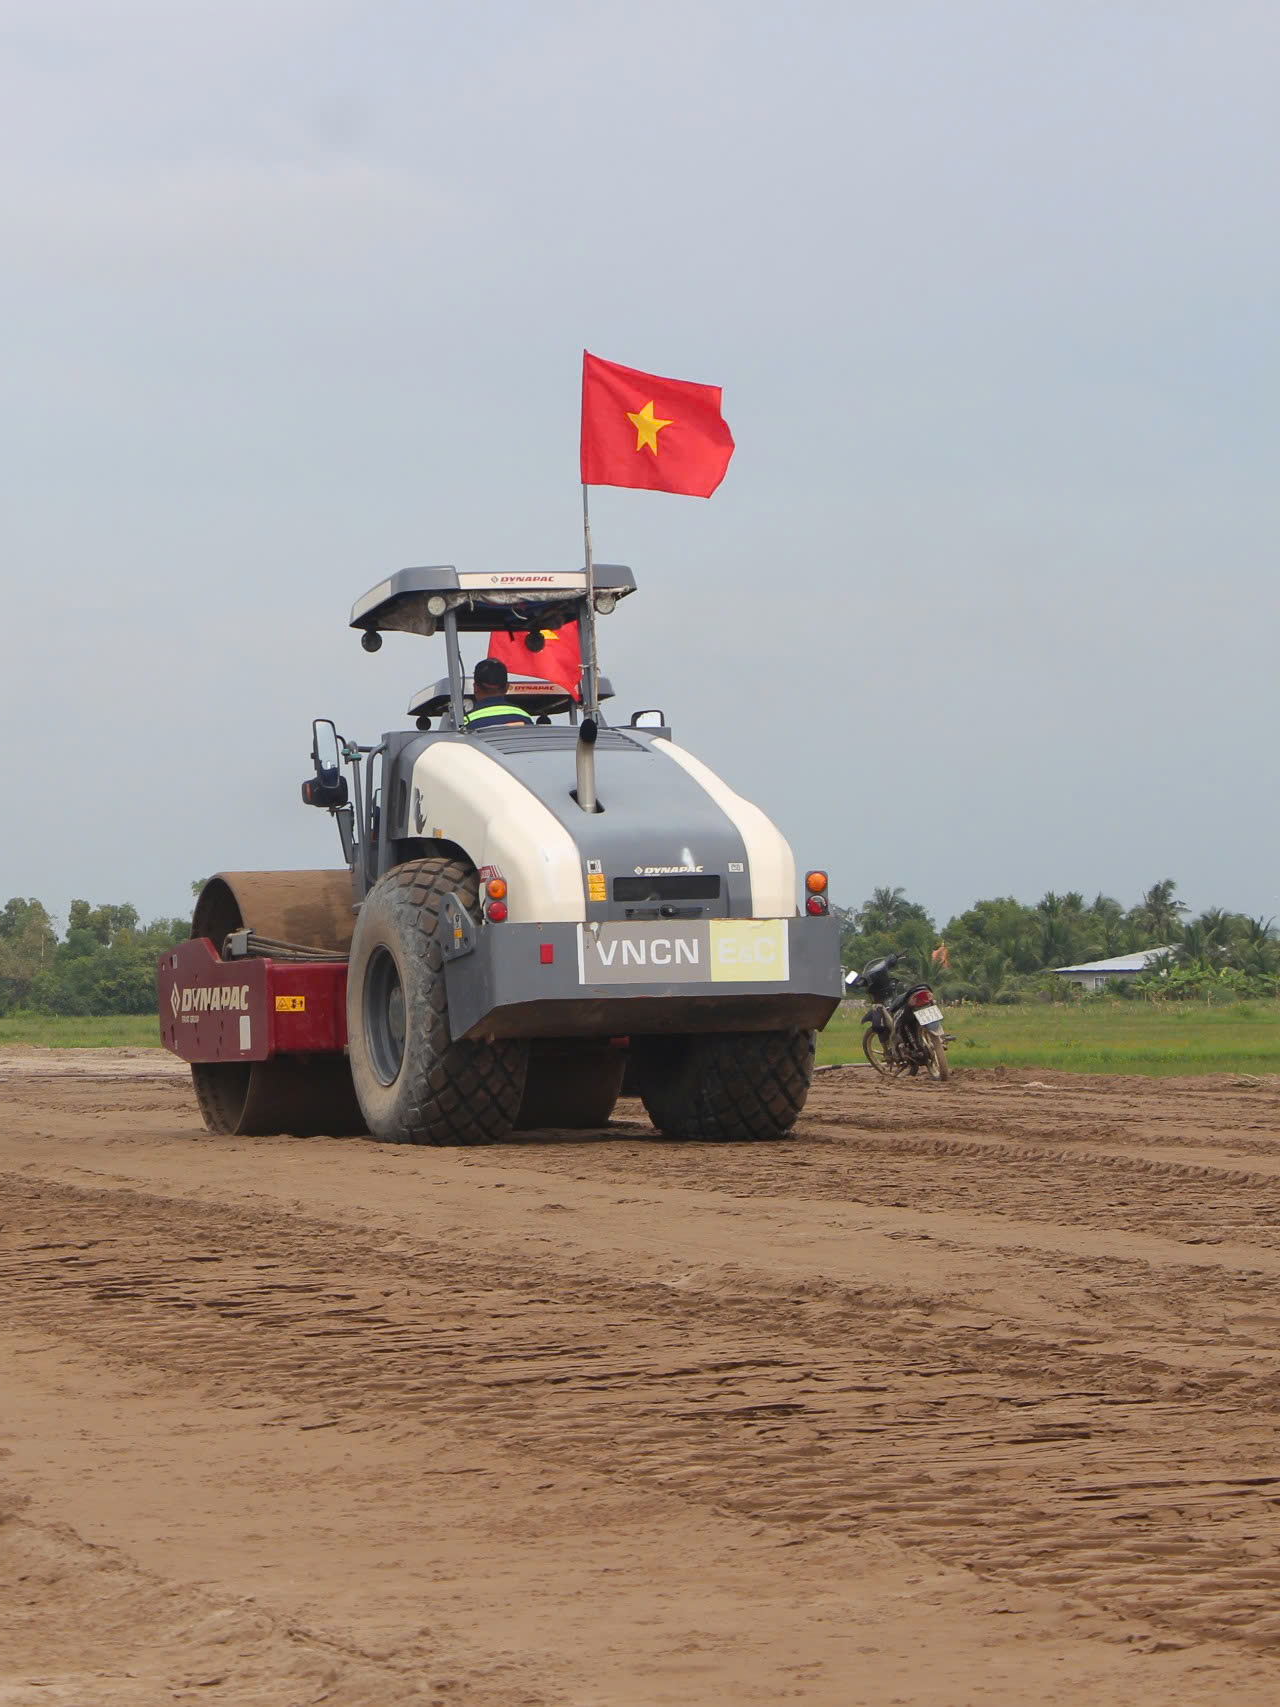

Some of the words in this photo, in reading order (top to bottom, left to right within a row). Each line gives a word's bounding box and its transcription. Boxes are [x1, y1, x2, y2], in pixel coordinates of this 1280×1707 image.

[644, 865, 704, 874] DYNAPAC
[596, 938, 700, 966] VNCN
[718, 937, 775, 965] E&C
[181, 985, 250, 1012] DYNAPAC
